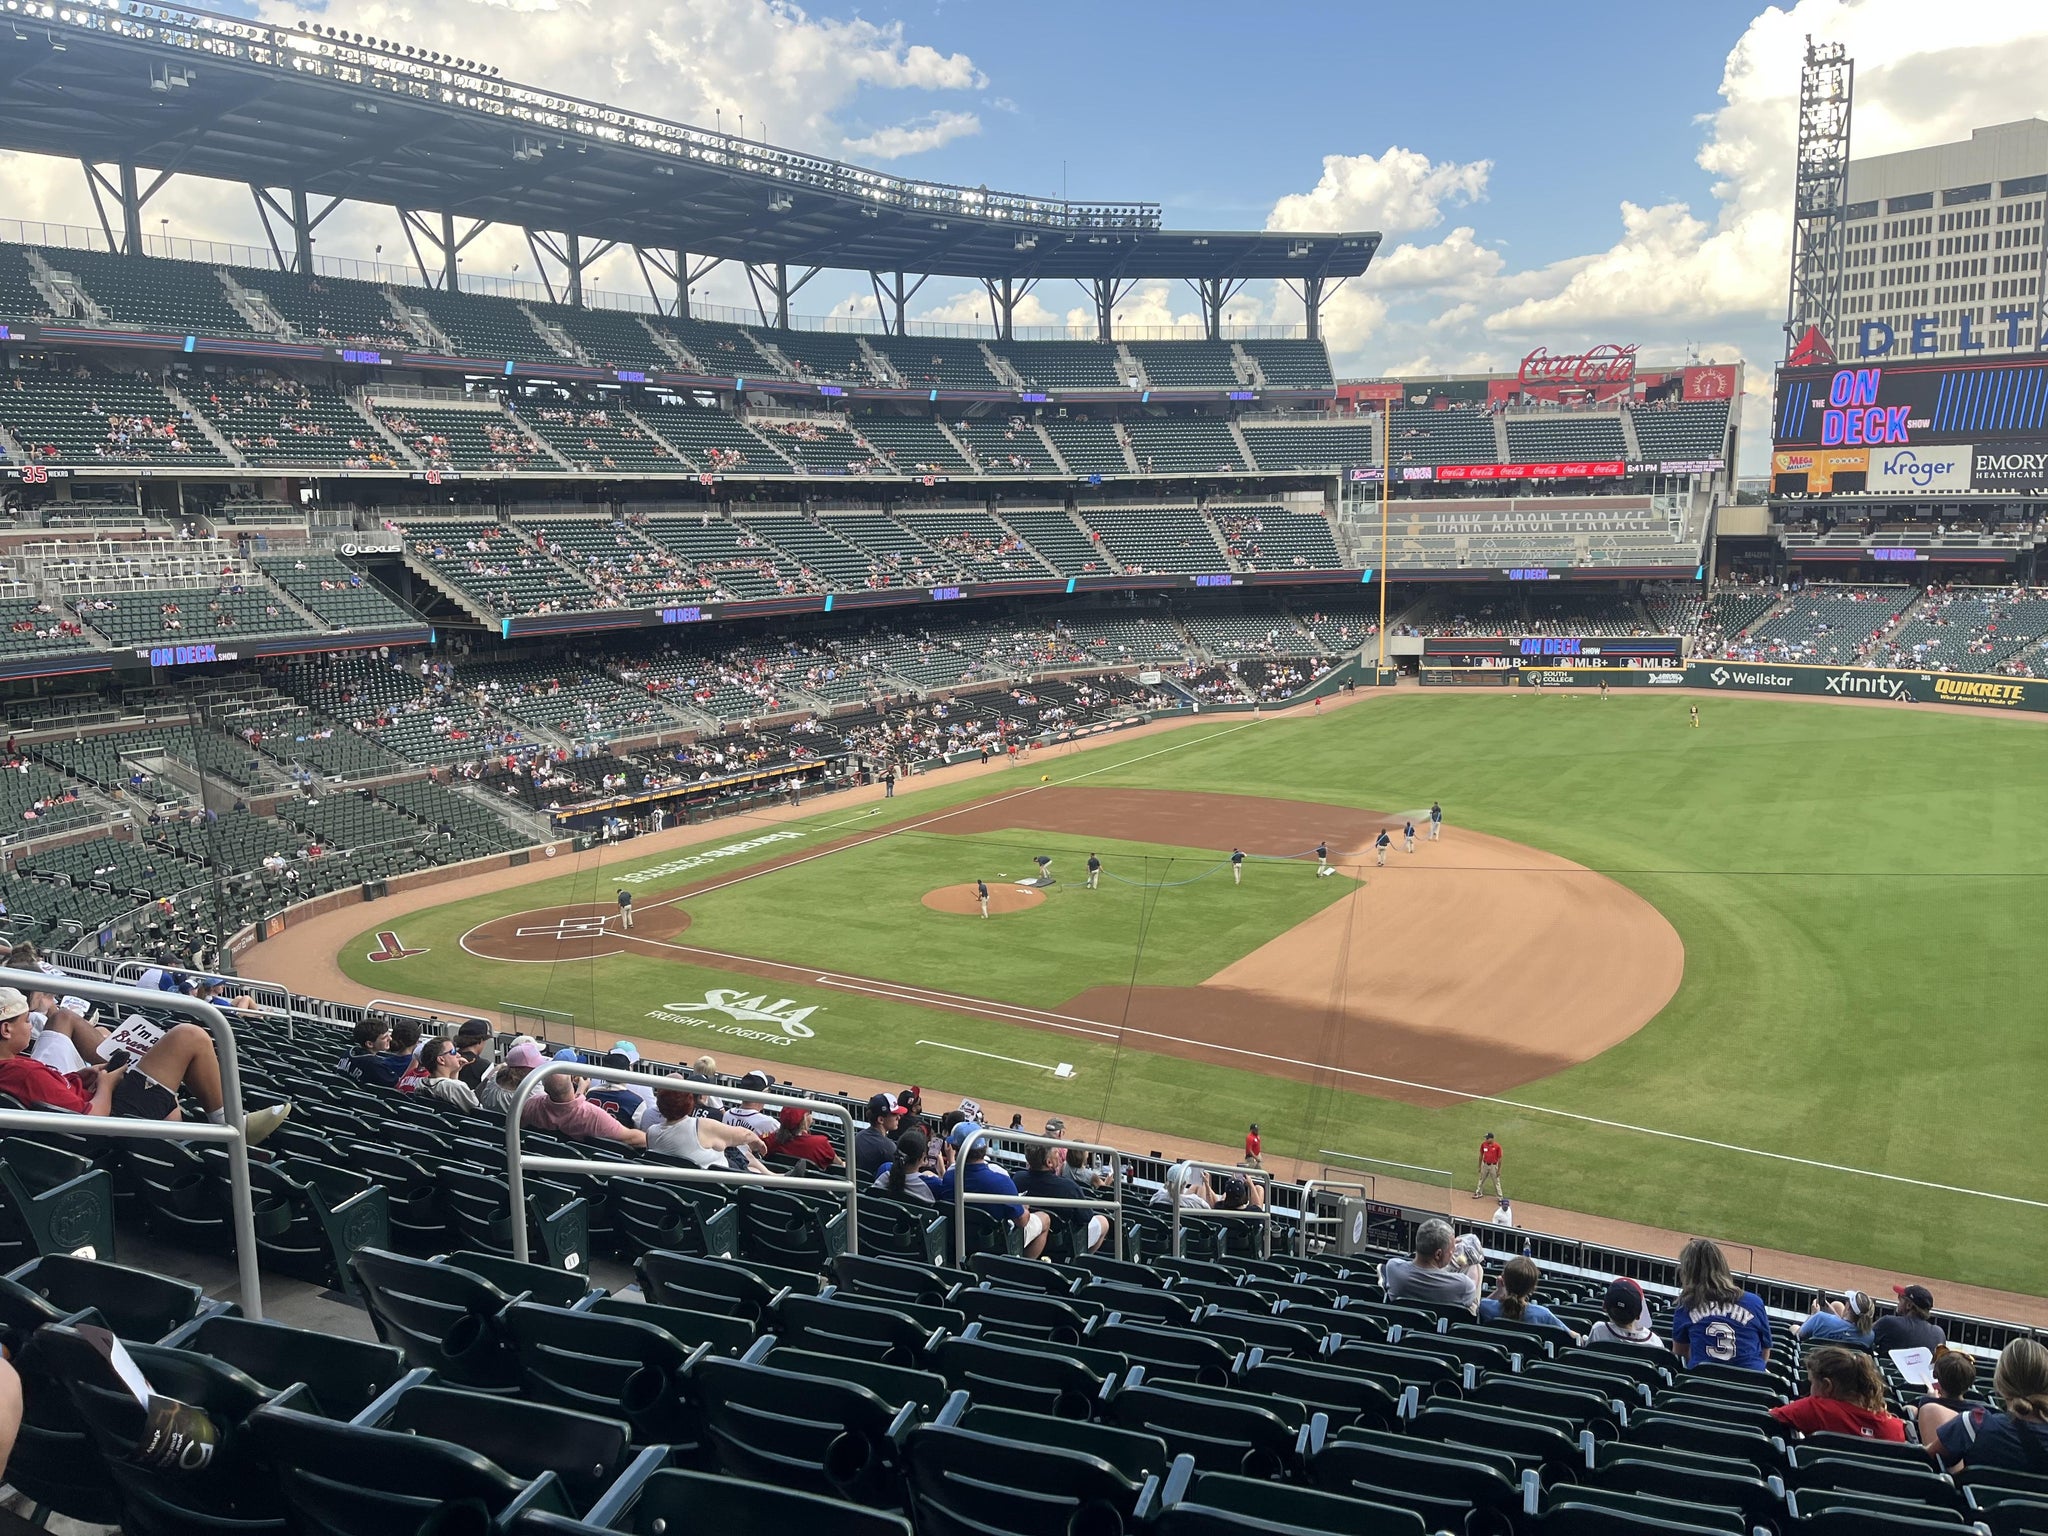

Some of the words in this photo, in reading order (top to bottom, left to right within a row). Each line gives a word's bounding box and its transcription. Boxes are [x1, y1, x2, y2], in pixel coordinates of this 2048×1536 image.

[1859, 310, 2048, 357] DELT
[1812, 399, 1825, 408] THE
[1829, 367, 1882, 407] ON
[1821, 405, 1911, 446] DECK
[1907, 418, 1931, 429] SHOW
[1645, 464, 1658, 472] PM
[1884, 450, 1955, 486] Kroger
[1976, 454, 2048, 471] EMORY
[22, 466, 48, 484] 35
[425, 470, 442, 485] 41
[699, 472, 713, 486] 44
[1976, 471, 2044, 479] HEALTHCARE
[1436, 513, 1482, 534] HANK
[1492, 512, 1554, 532] AARON
[1560, 511, 1651, 532] TERRACE
[358, 545, 401, 554] LEXUS
[1520, 638, 1541, 655] ON
[1544, 638, 1581, 655] DECK
[1582, 647, 1600, 655] SHOW
[136, 650, 149, 658] THE
[150, 648, 174, 667] ON
[176, 644, 218, 664] DECK
[218, 652, 238, 661] SHOW
[1496, 657, 1528, 668] MLB+
[1574, 657, 1608, 668] MLB+
[1643, 657, 1678, 668] MLB+
[1733, 671, 1793, 686] Wellstar
[1825, 671, 1904, 698] xfinity
[1934, 678, 2024, 700] QUIKRETE
[644, 1010, 708, 1028] FREIGHT
[716, 1024, 798, 1046] LOGISTICS
[1379, 1206, 1398, 1216] ALERT
[1688, 1301, 1754, 1326] MURPHY
[1706, 1322, 1736, 1361] 3
